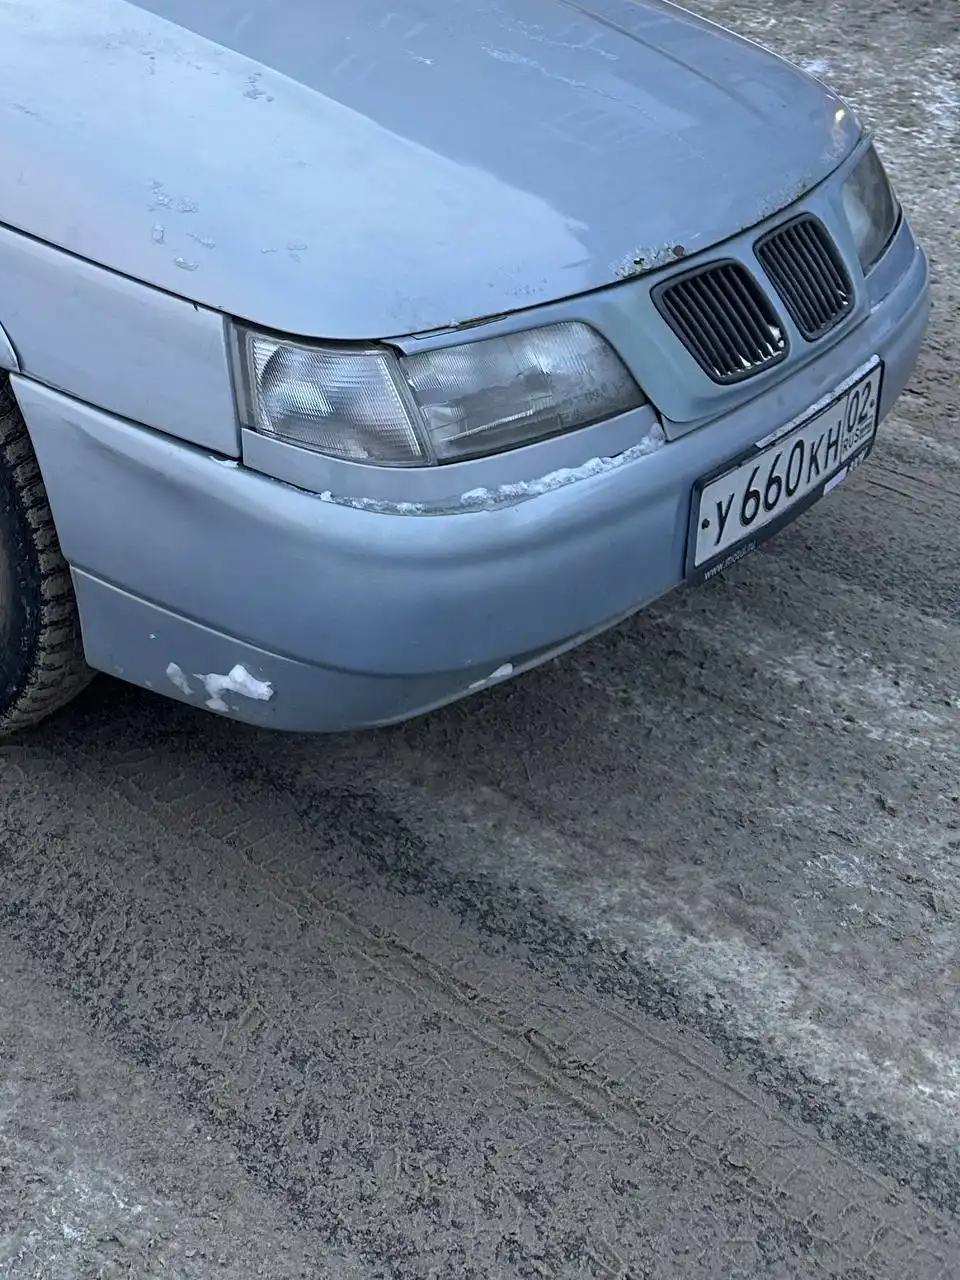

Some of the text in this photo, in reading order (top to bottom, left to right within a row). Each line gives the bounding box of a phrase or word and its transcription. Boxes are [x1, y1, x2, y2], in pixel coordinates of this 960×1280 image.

[847, 380, 872, 433] 02
[842, 428, 862, 453] RUS
[714, 420, 842, 546] У660КН
